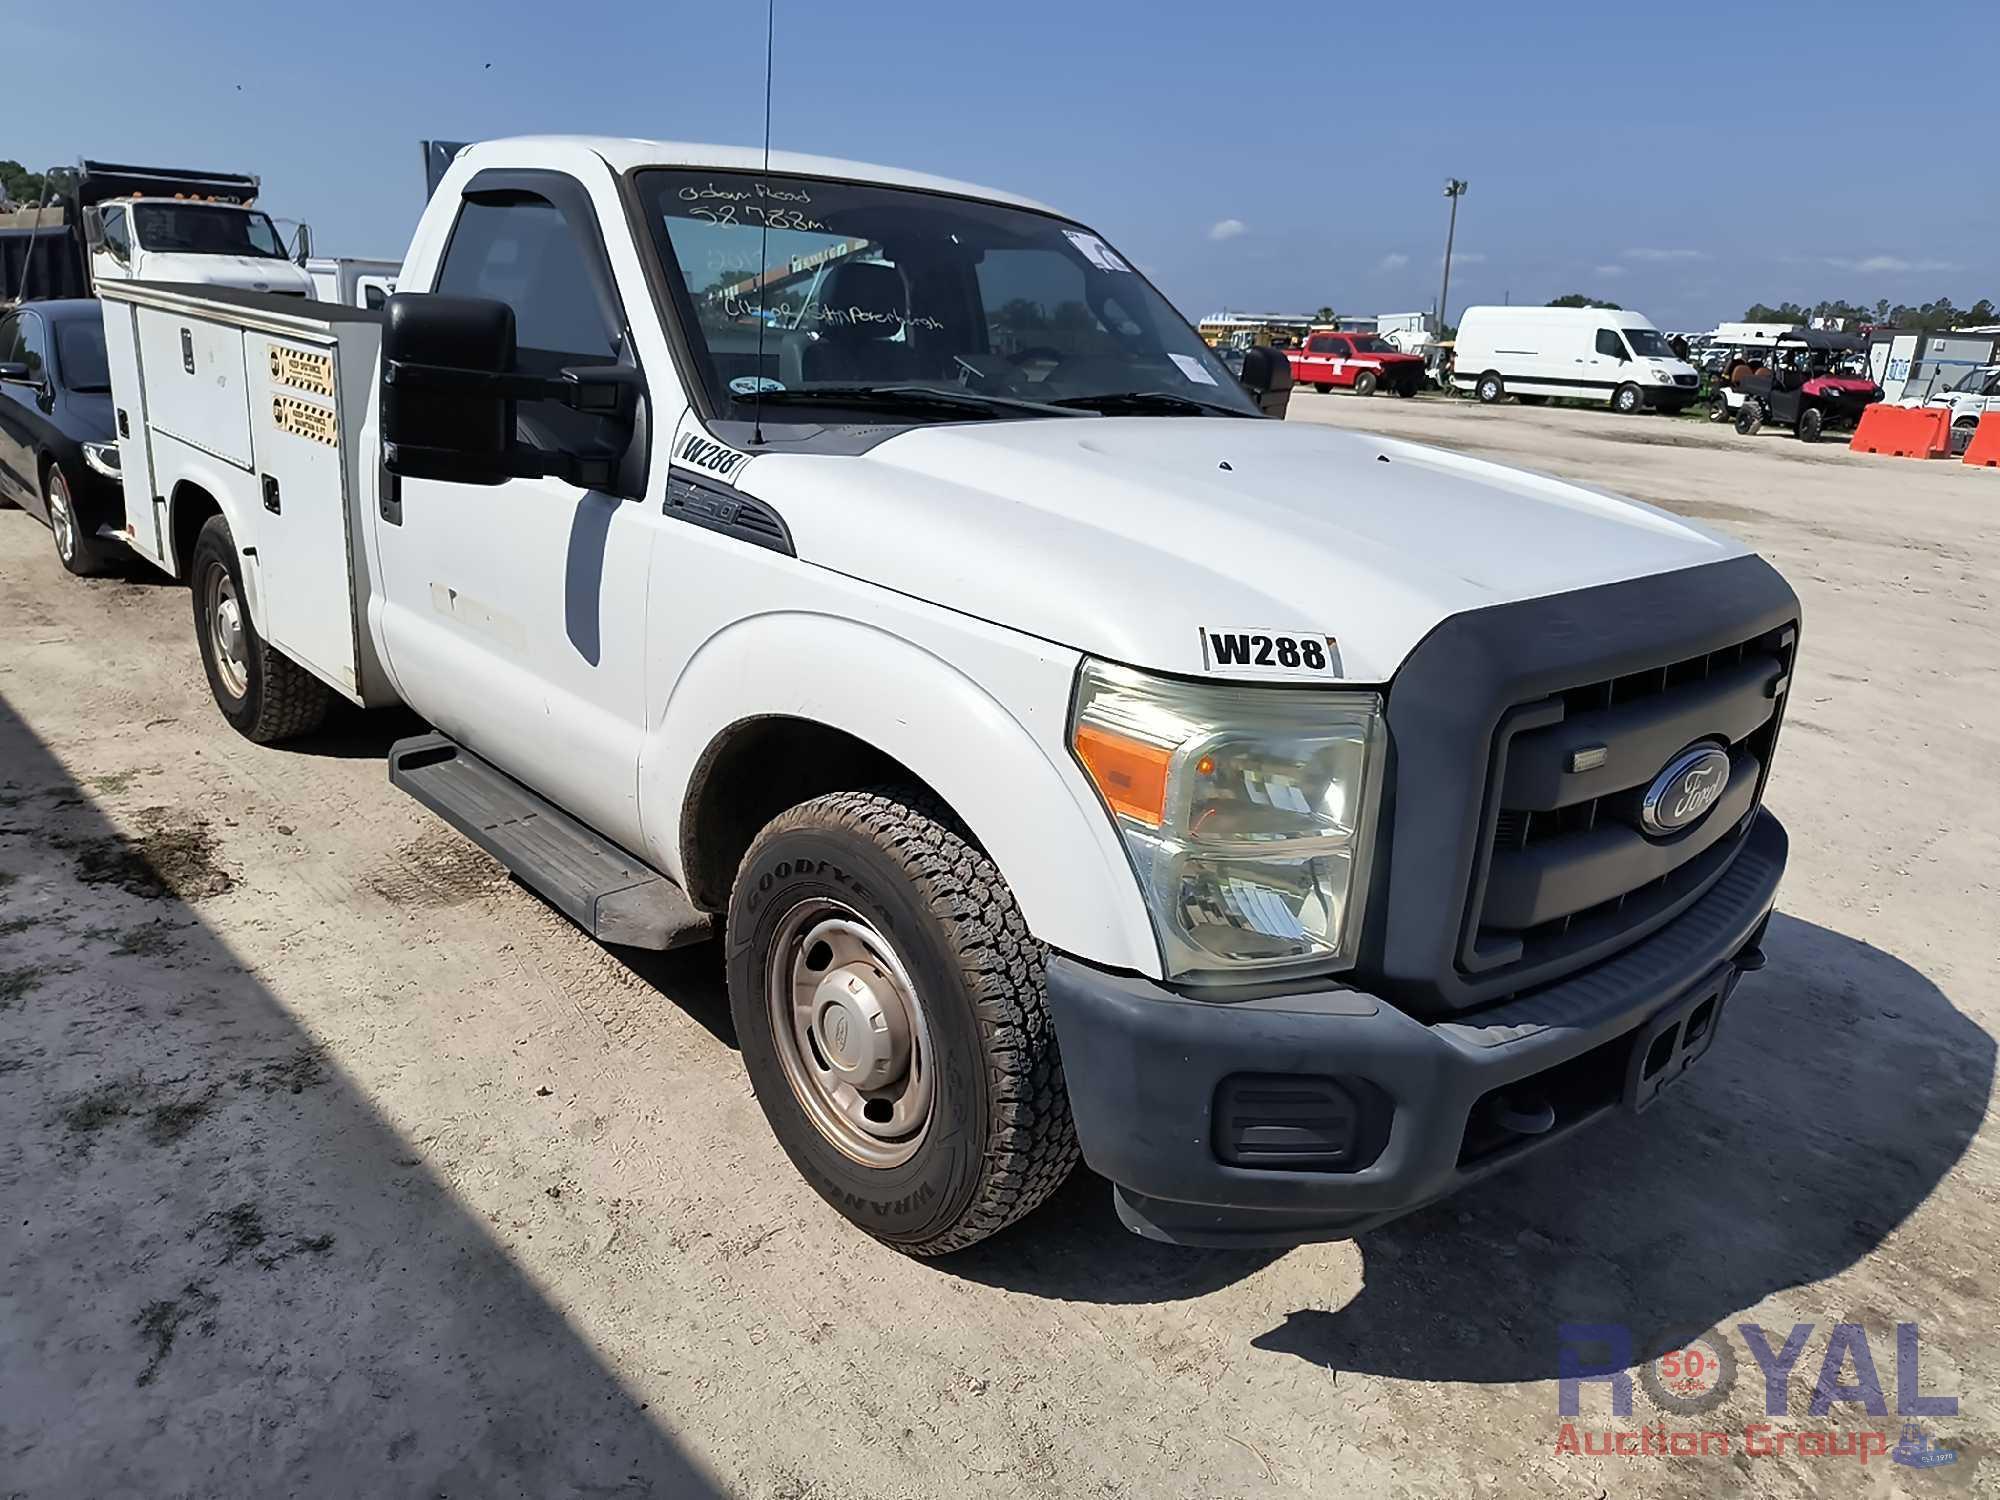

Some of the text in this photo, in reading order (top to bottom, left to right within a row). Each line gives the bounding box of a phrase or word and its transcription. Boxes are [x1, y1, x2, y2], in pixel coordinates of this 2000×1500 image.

[681, 436, 743, 474] W288
[1209, 634, 1326, 671] W288
[1674, 766, 1722, 818] Ford
